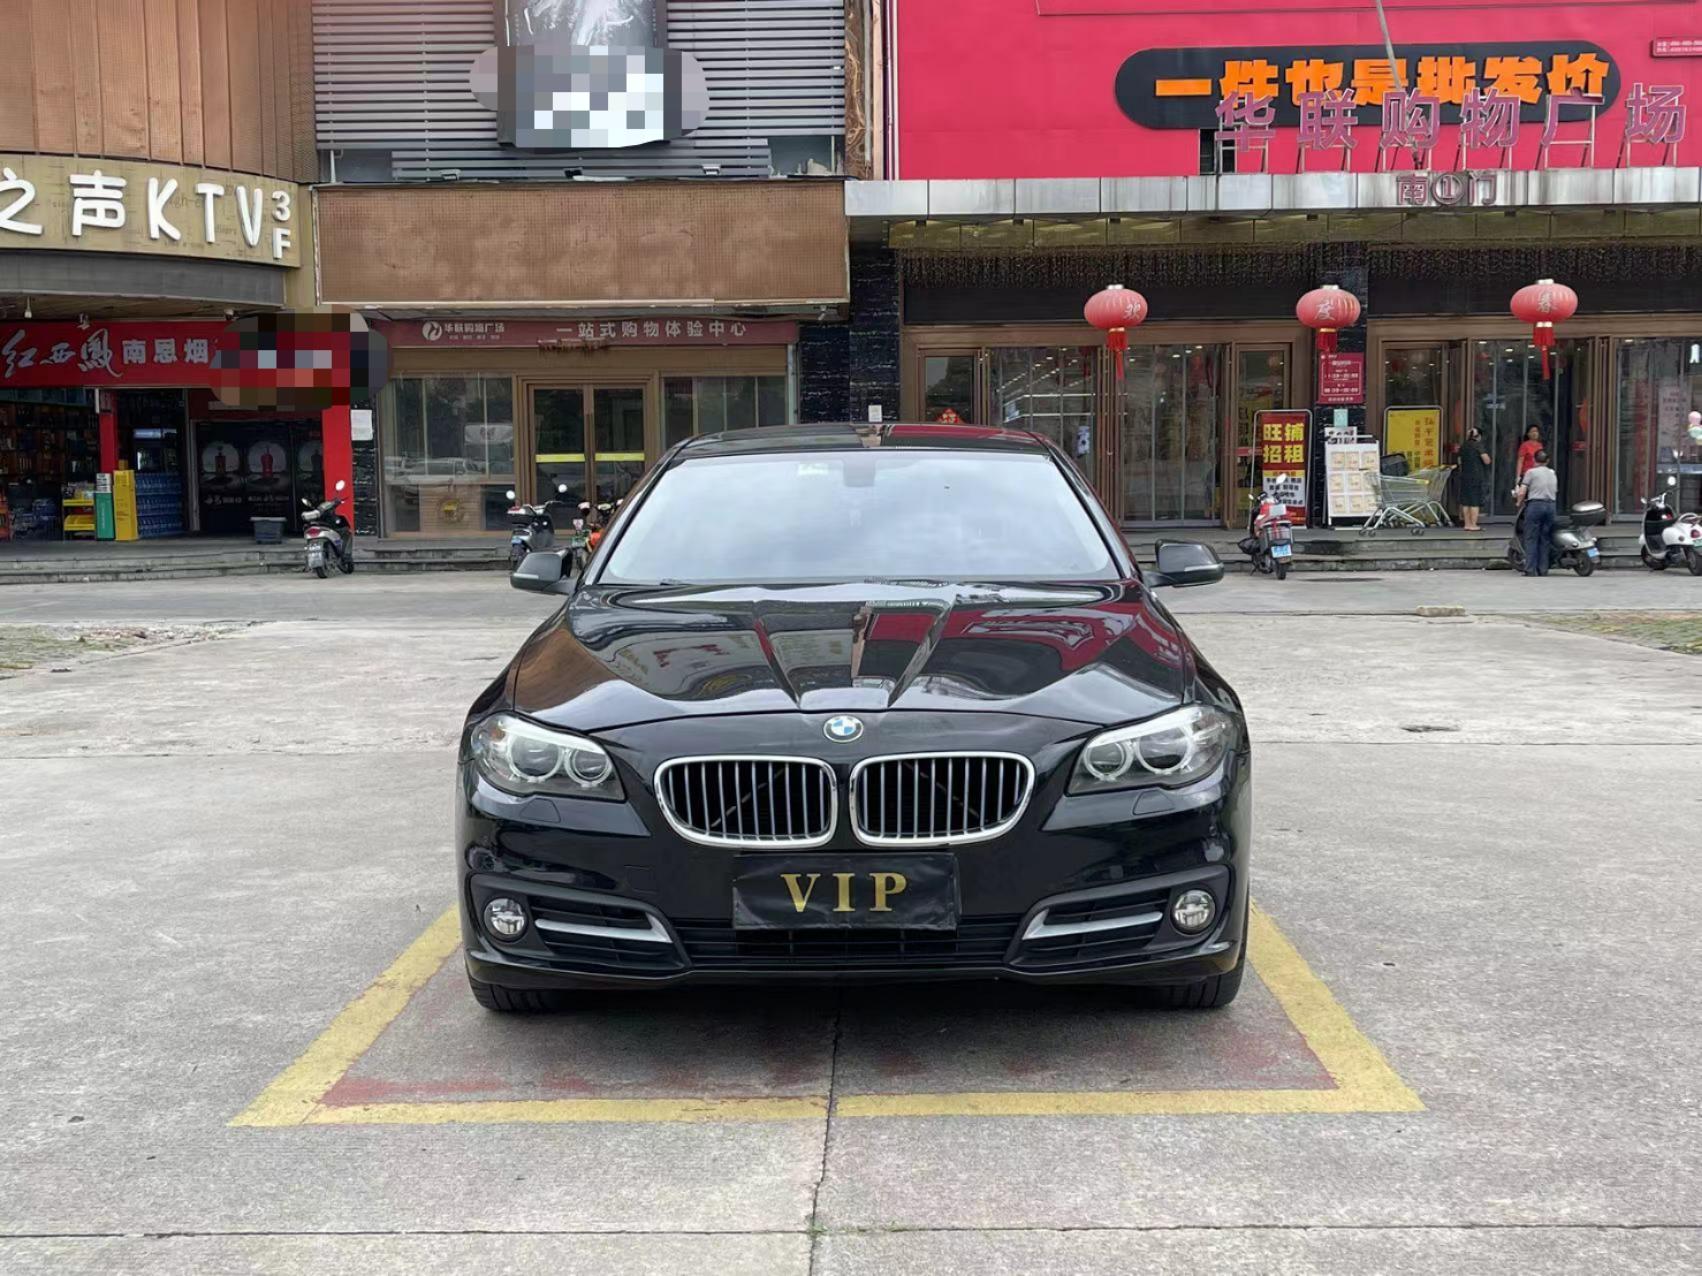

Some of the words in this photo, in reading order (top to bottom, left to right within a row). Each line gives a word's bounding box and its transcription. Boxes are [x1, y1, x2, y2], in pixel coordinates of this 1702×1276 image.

[1155, 53, 1610, 107] 一件也是批发价
[1215, 82, 1687, 152] 华联购物广场
[556, 320, 747, 338] 一站式购物体验中心
[122, 338, 218, 364] 南恩烟
[1263, 422, 1304, 441] 旺铺
[1263, 444, 1304, 464] 招租
[780, 872, 907, 913] VIP
